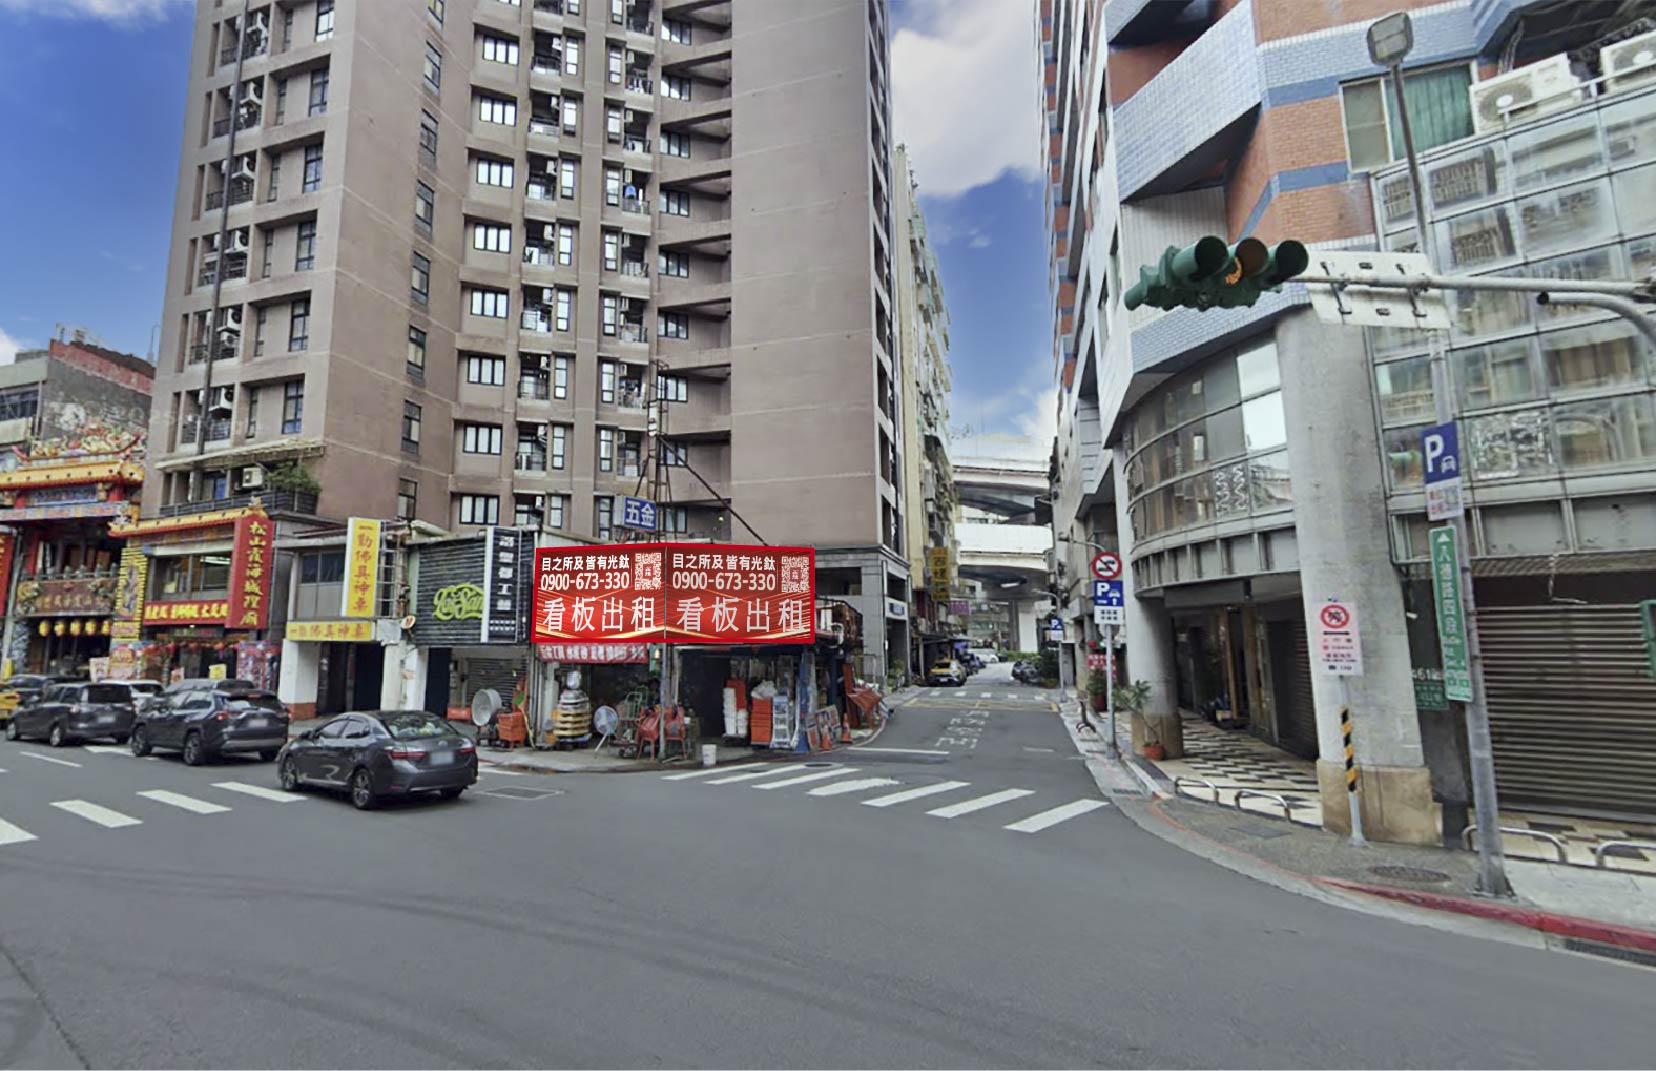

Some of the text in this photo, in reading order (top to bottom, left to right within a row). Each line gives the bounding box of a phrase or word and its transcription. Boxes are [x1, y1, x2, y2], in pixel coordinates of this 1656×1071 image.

[1424, 434, 1444, 473] P
[626, 500, 655, 527] 五金
[542, 554, 630, 572] 目之所及 皆有光鈦
[672, 553, 776, 571] 目之所及 皆有光鈦
[540, 572, 630, 591] 0900-673-330
[672, 571, 776, 591] 0900-673-330
[1096, 582, 1110, 597] P
[542, 596, 657, 633] 看板出租
[676, 596, 806, 633] 看板出租
[1051, 619, 1059, 628] P
